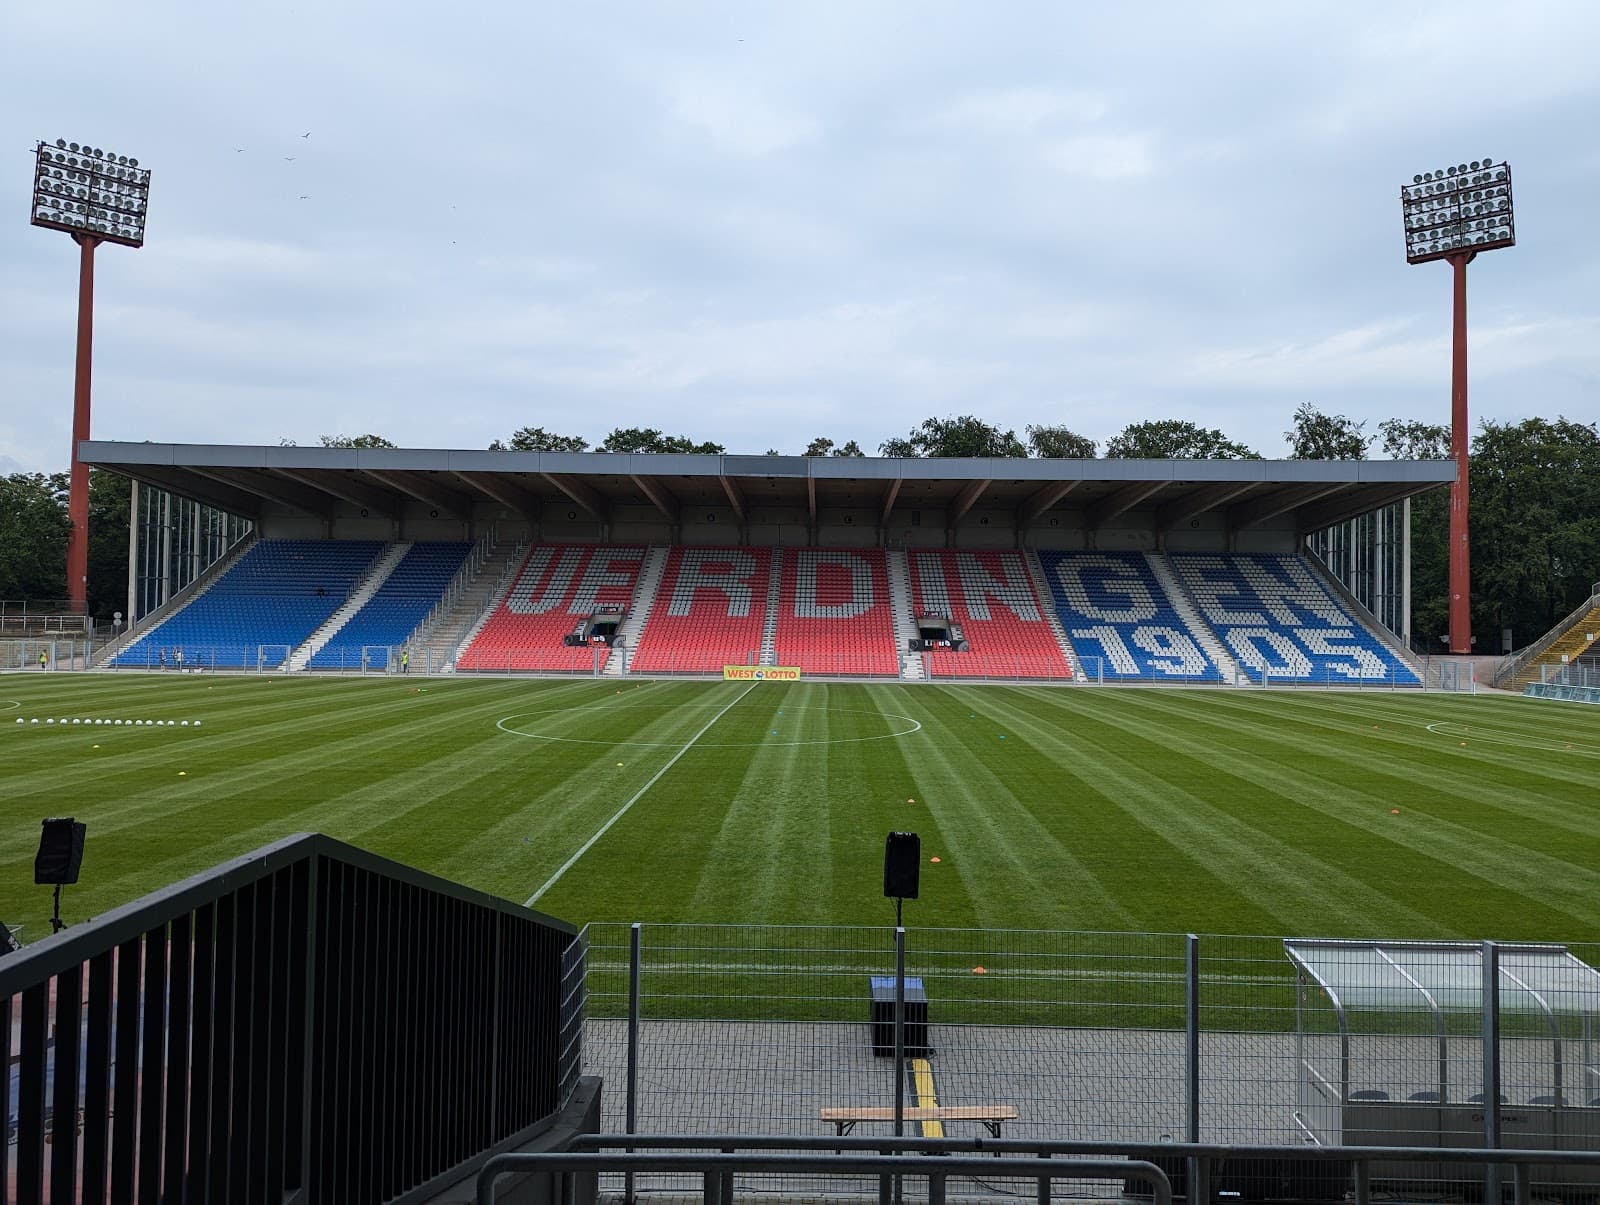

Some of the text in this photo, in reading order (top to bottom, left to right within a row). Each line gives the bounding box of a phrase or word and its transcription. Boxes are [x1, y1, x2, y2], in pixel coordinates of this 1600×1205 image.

[506, 546, 1353, 626] UERDINGEN
[728, 669, 797, 679] WEST LOTTO
[1071, 625, 1387, 679] 1905
